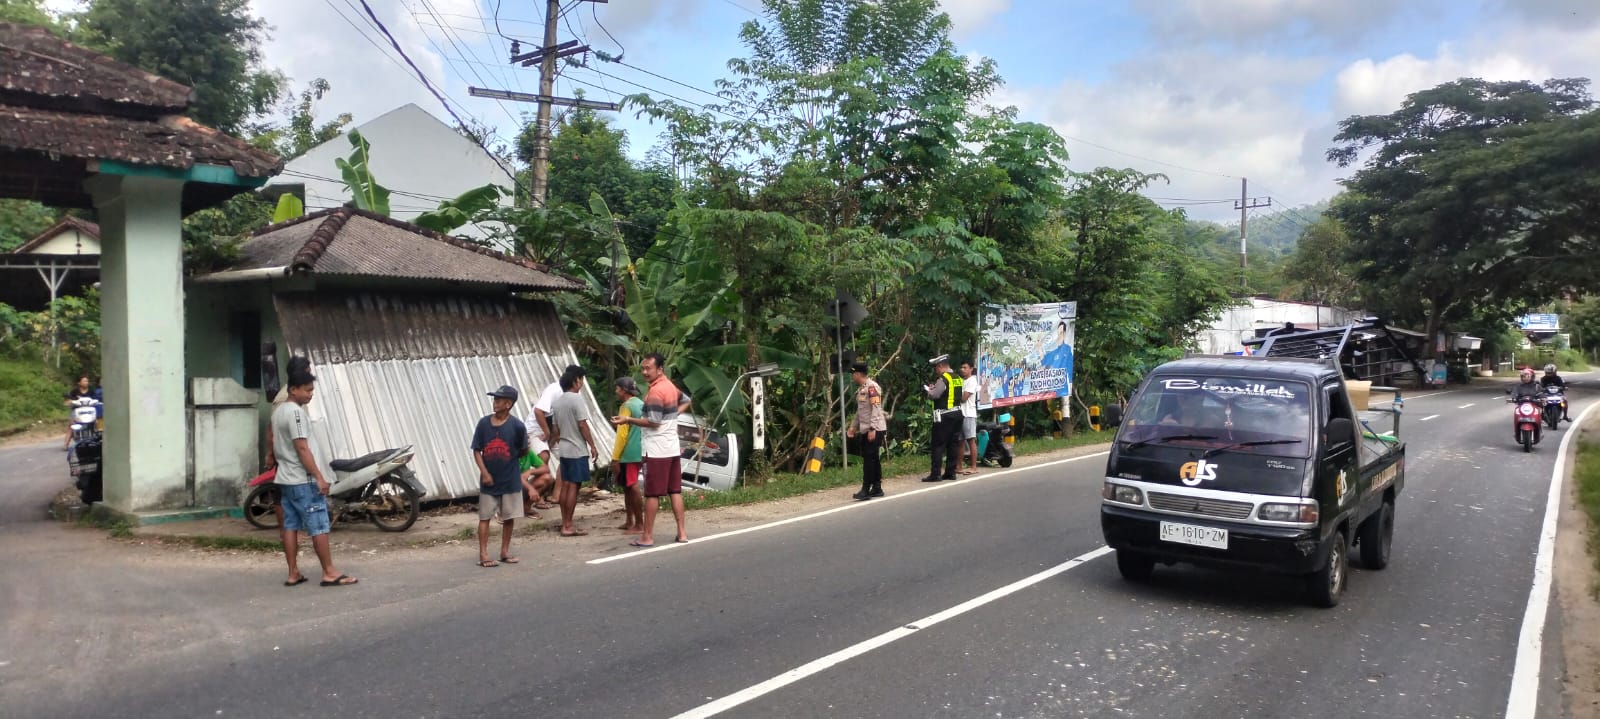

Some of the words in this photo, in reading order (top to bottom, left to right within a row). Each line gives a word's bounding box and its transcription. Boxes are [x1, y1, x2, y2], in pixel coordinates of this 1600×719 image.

[1160, 378, 1295, 397] Bismillah
[1162, 524, 1174, 536] AE
[1182, 526, 1204, 540] 1610
[1212, 530, 1225, 542] ZM
